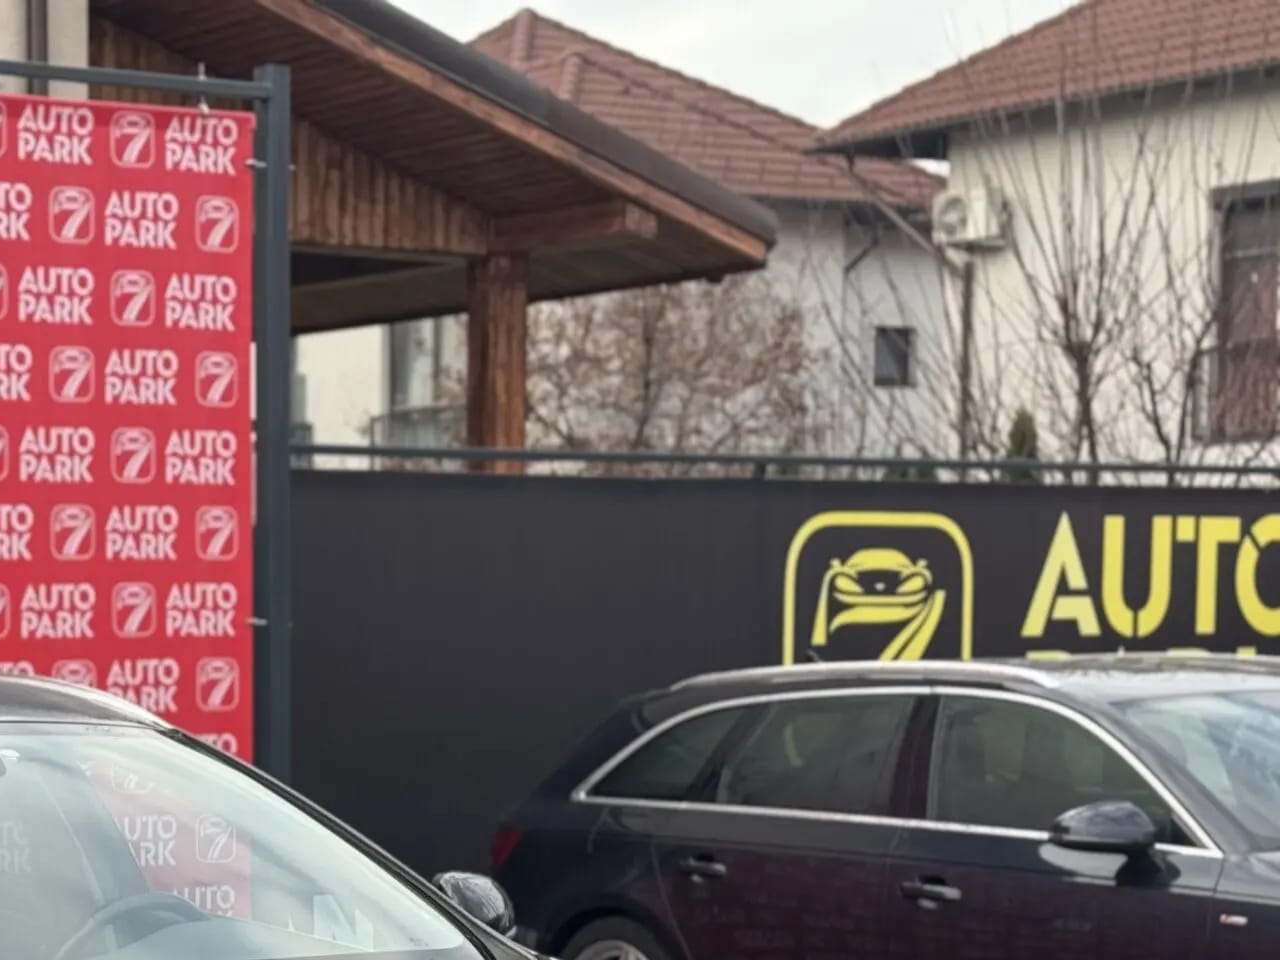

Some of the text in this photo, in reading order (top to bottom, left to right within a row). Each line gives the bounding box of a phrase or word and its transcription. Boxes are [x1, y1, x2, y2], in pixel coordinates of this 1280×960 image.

[18, 104, 93, 135] AUTO
[164, 116, 238, 145] AUTO
[18, 133, 92, 164] PARK
[165, 145, 234, 175] PARK
[105, 192, 178, 221] AUTO
[106, 220, 176, 249] PARK
[18, 268, 94, 297] AUTO
[165, 276, 236, 303] AUTO
[19, 295, 92, 326] PARK
[165, 303, 234, 331] PARK
[105, 350, 178, 377] AUTO
[106, 377, 176, 405] PARK
[21, 427, 95, 454] AUTO
[165, 431, 236, 457] AUTO
[21, 454, 93, 482] PARK
[165, 457, 234, 485] PARK
[105, 506, 178, 532] AUTO
[106, 533, 177, 560] PARK
[21, 584, 95, 611] AUTO
[166, 583, 237, 609] AUTO
[21, 611, 94, 639] PARK
[166, 609, 235, 637] PARK
[107, 659, 178, 685] AUTO
